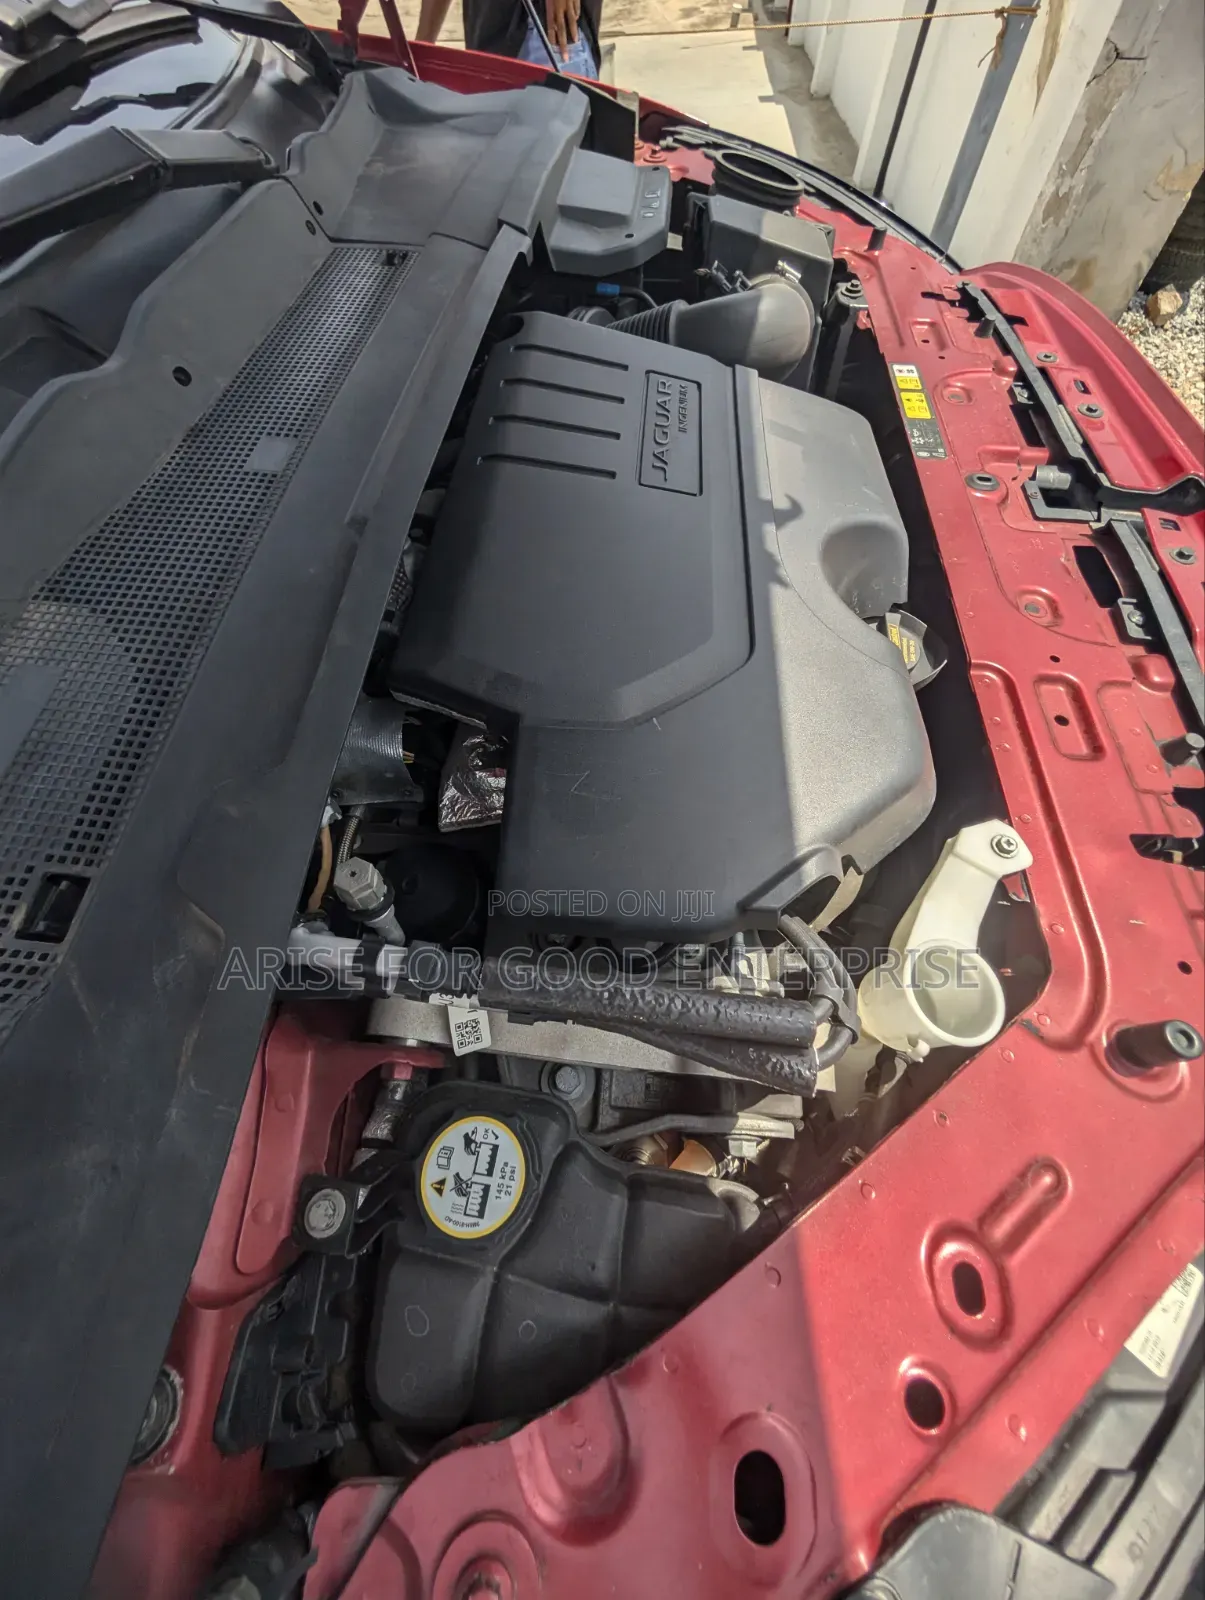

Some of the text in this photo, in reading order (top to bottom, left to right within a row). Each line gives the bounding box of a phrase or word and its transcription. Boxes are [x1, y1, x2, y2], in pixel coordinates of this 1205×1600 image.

[651, 379, 672, 482] JAGUAR
[482, 1127, 490, 1140] OK
[495, 1161, 509, 1200] 145 kPa
[504, 1166, 517, 1196] 21 psi
